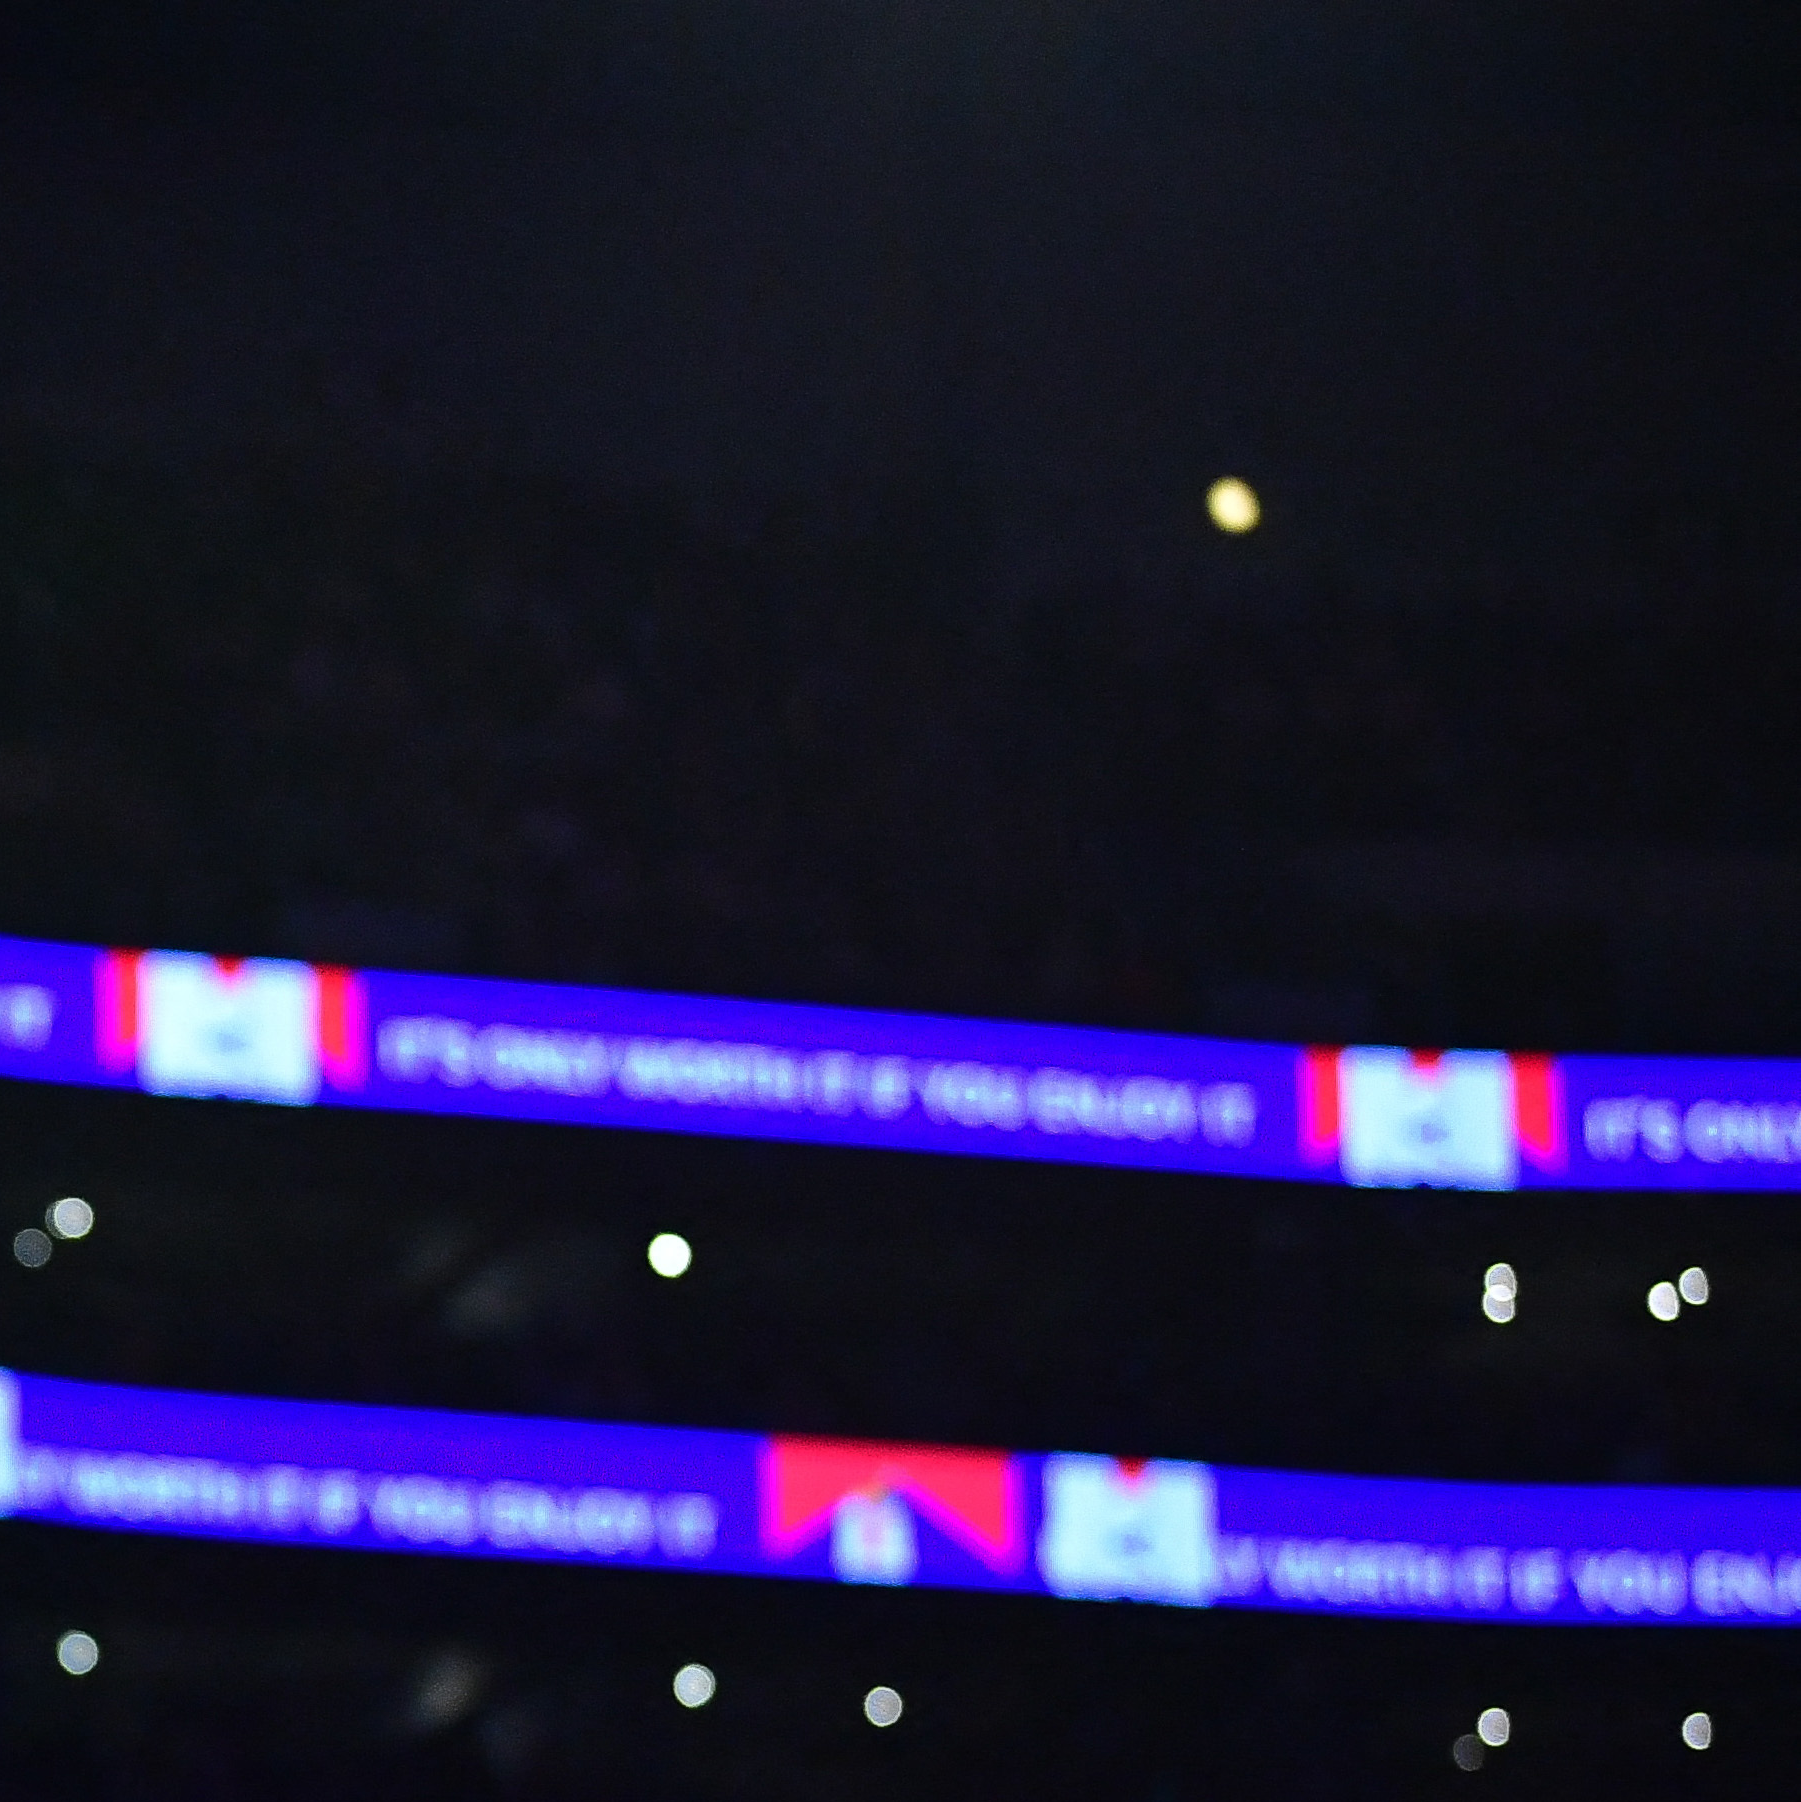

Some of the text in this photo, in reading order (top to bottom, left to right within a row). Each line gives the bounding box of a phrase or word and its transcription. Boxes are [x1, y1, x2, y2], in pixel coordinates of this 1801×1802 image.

[379, 1017, 480, 1087] IT'S
[481, 1022, 617, 1096] ONLY
[620, 1033, 802, 1112] WORTH
[923, 1060, 1028, 1133] YOU
[1029, 1066, 1198, 1145] ENJOY
[1200, 1080, 1259, 1150] IT
[67, 1447, 247, 1524] WORTH
[372, 1471, 481, 1545] YOU
[482, 1478, 657, 1557] ENJOY
[658, 1490, 718, 1560] IT
[1271, 1539, 1447, 1612] WORTH
[1569, 1549, 1687, 1616] YOU
